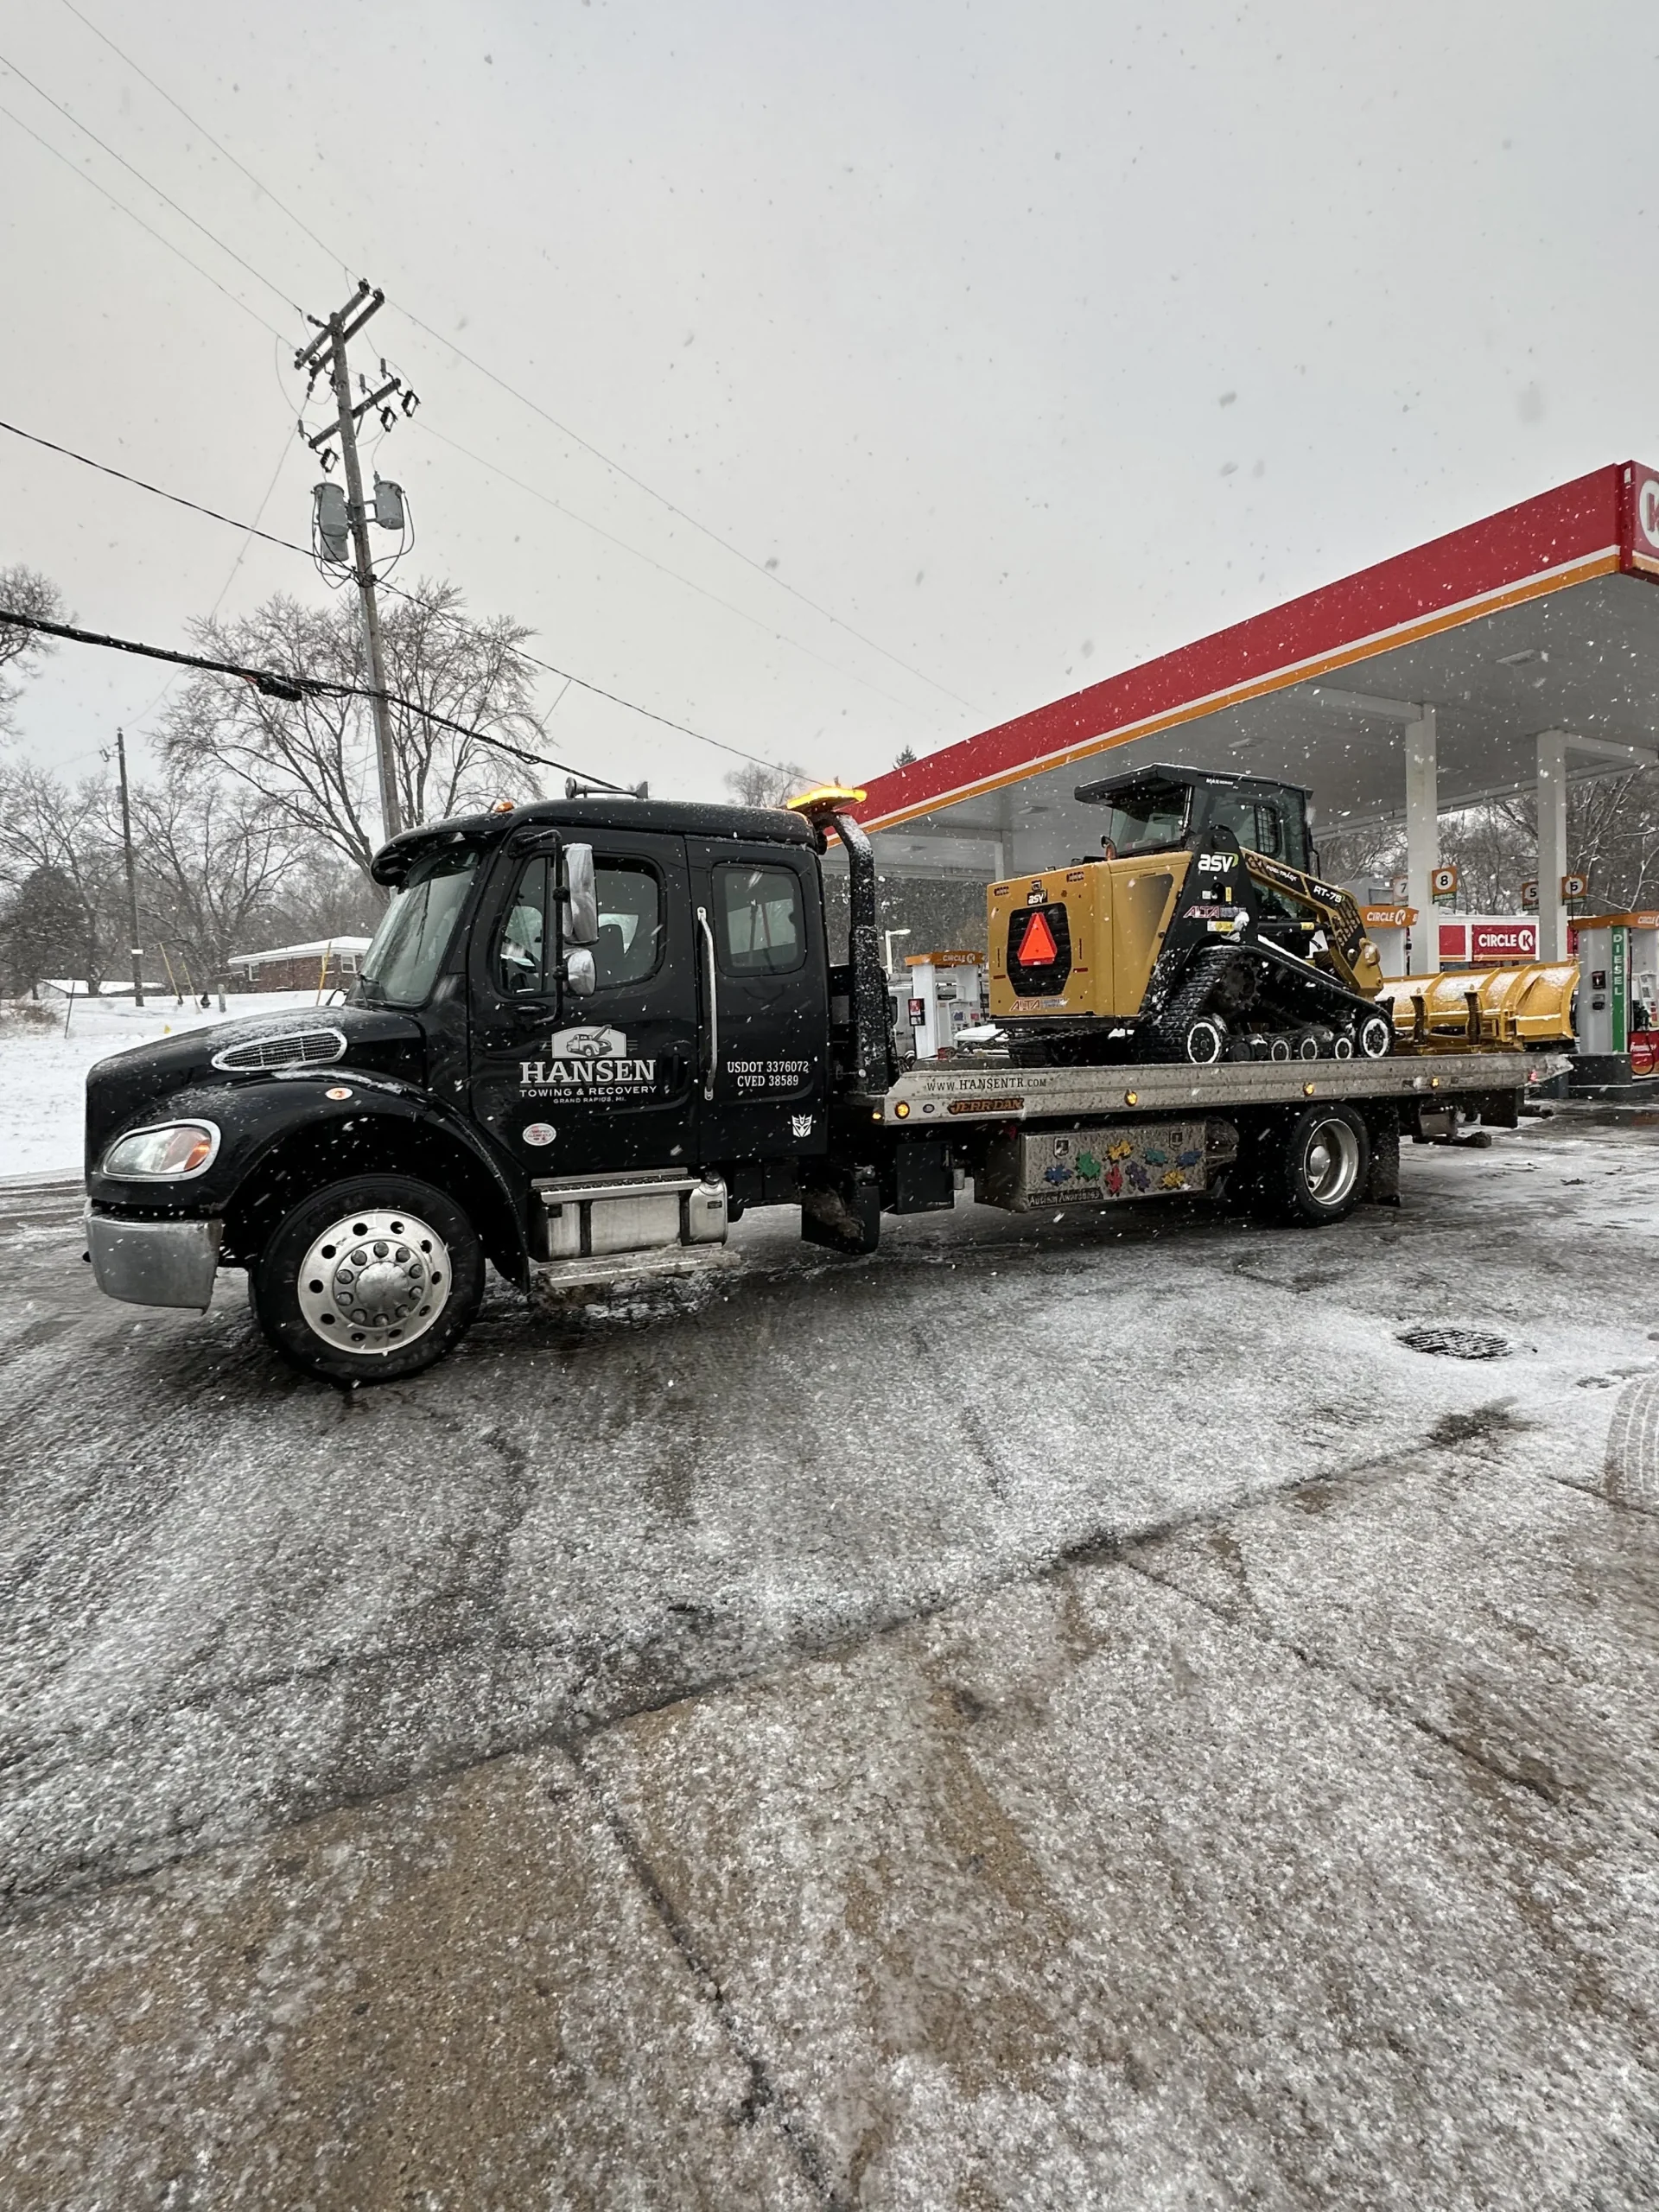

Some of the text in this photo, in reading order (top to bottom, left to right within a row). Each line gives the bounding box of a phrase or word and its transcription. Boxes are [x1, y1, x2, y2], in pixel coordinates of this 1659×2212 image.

[1440, 875, 1448, 886] 8
[1400, 882, 1408, 893] 7
[1529, 887, 1537, 898] 5
[1183, 906, 1220, 918] ALTA
[1367, 912, 1395, 922] CIRCLE
[1478, 933, 1516, 948] CIRCLE
[1612, 934, 1624, 995] DIESEL
[519, 1059, 657, 1085] HANSEN
[727, 1061, 810, 1073] USDOT 3376072
[737, 1075, 799, 1087] CVED 38589
[519, 1085, 657, 1097] TOWING & RECOVERY
